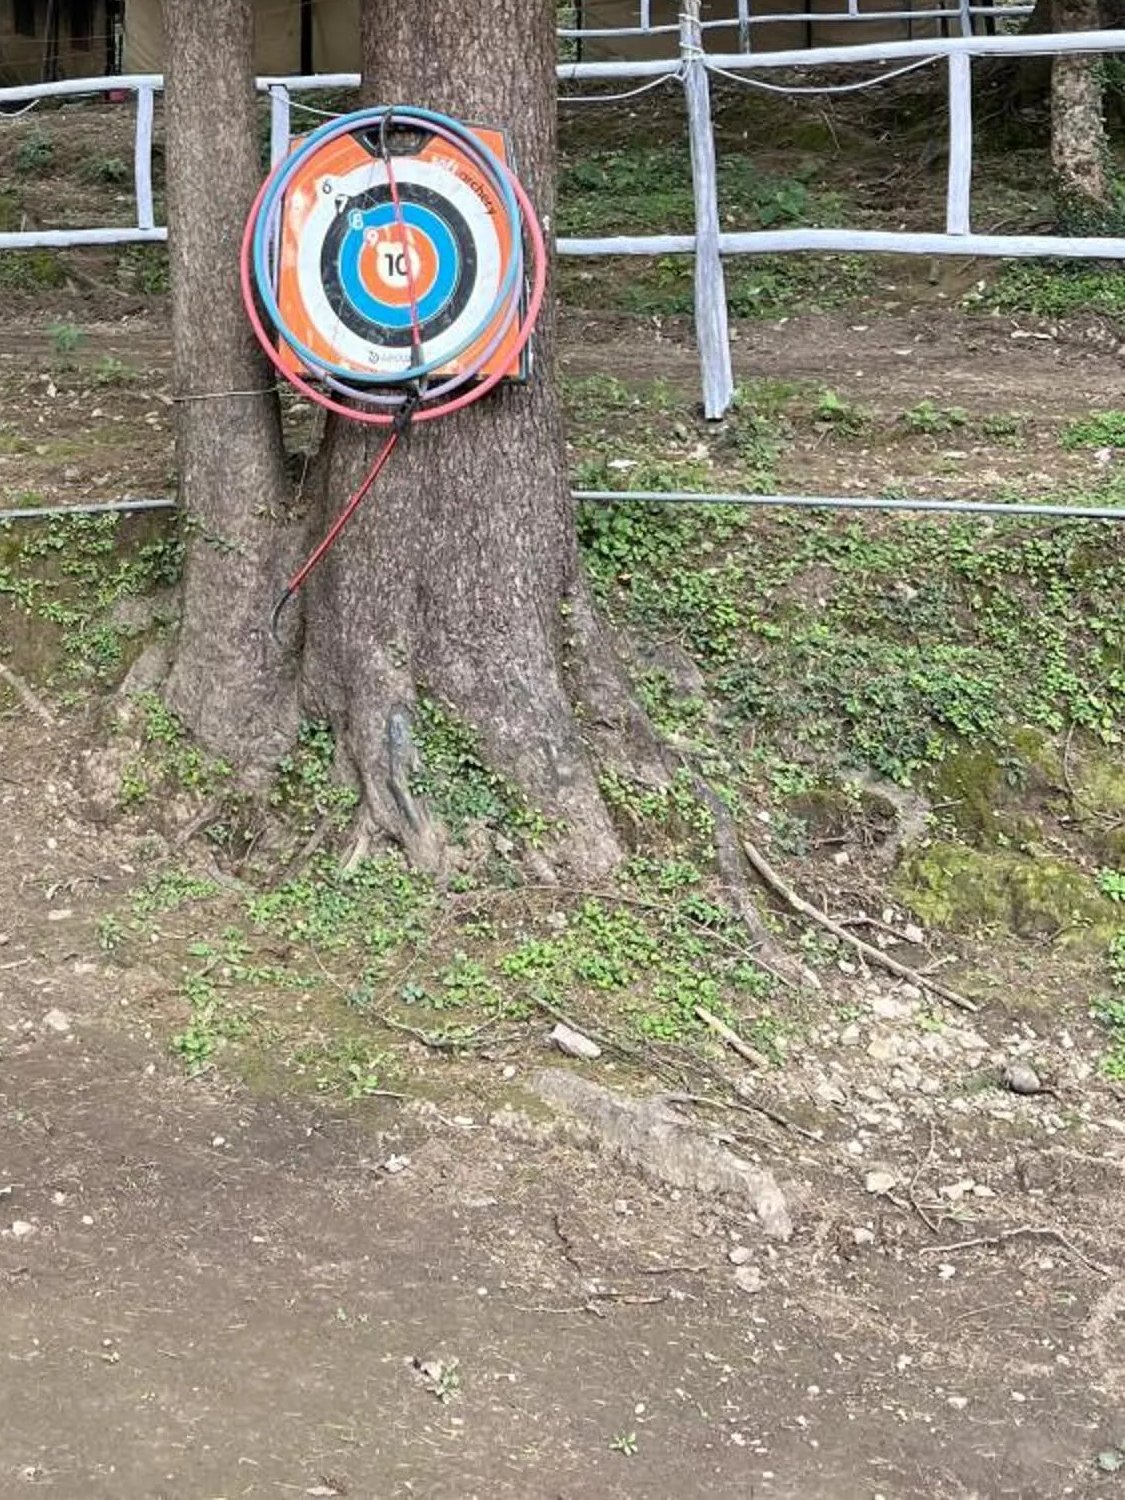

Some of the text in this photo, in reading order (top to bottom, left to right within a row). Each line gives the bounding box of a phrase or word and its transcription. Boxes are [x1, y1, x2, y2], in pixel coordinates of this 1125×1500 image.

[322, 178, 332, 195] 6
[337, 194, 349, 214] 7
[352, 212, 364, 231] 8
[366, 229, 379, 247] 9
[384, 253, 412, 277] 10
